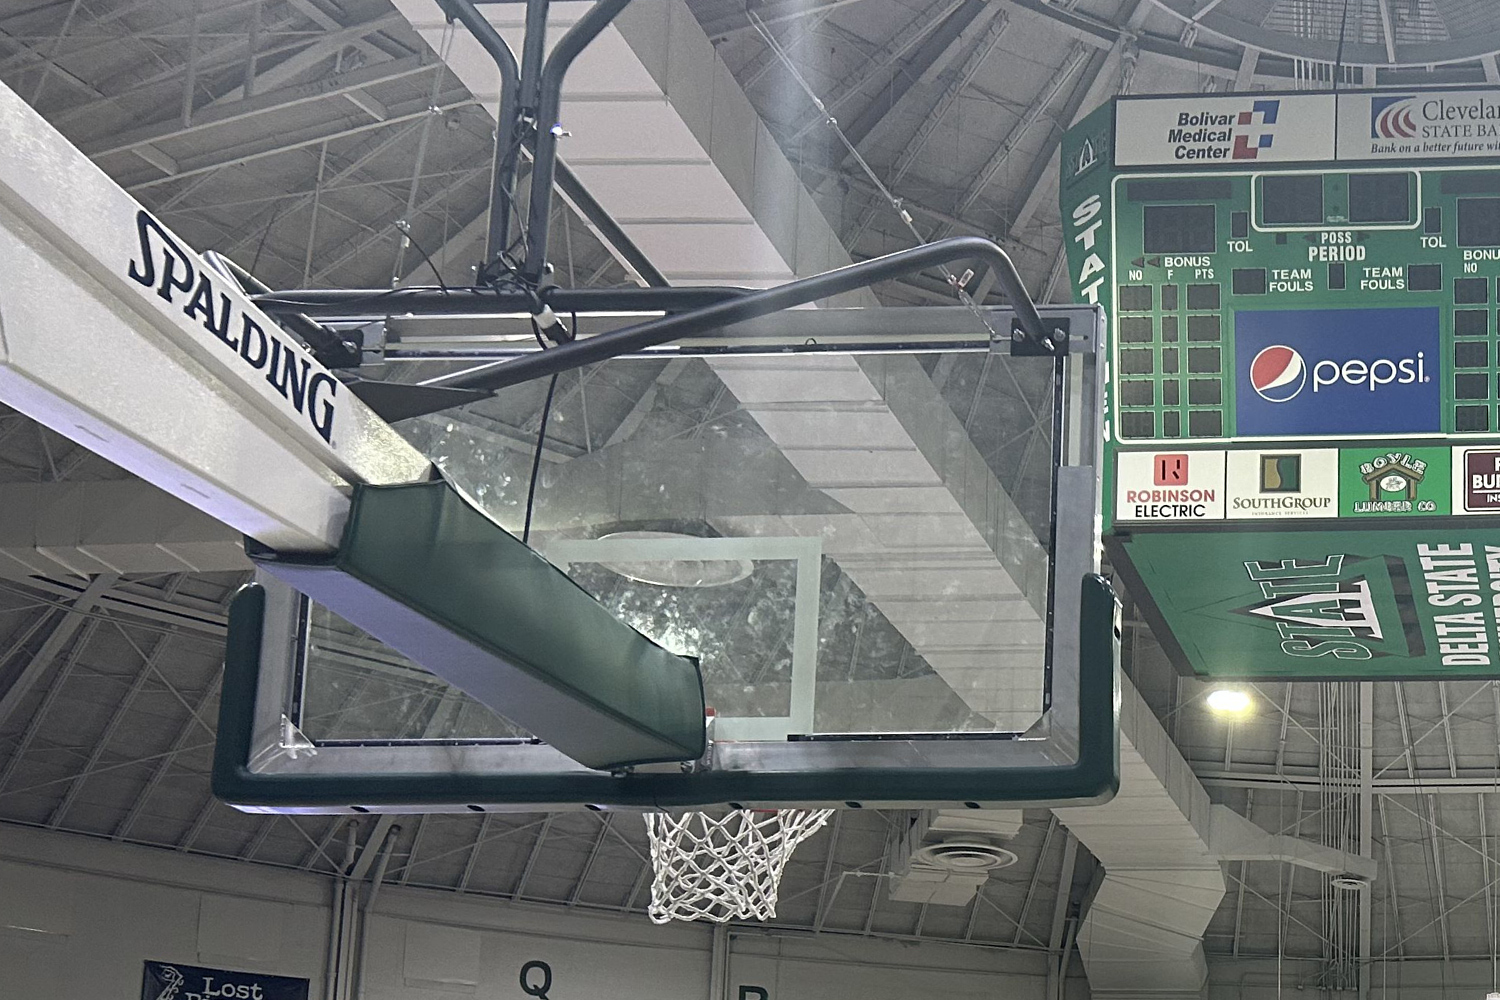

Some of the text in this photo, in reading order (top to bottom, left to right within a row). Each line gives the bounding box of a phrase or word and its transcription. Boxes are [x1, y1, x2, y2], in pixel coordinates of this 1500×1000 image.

[1178, 112, 1235, 126] Bolivar
[1168, 128, 1232, 143] Medical
[1422, 126, 1472, 138] STATE
[1175, 145, 1230, 159] Center
[1371, 143, 1396, 153] Bank
[1399, 145, 1410, 153] on
[1423, 142, 1451, 152] better
[1452, 141, 1484, 154] future
[1321, 232, 1352, 244] POSS
[1420, 237, 1446, 248] TOL
[1227, 241, 1253, 253] TOL
[1309, 246, 1365, 262] PERIOD
[1164, 257, 1210, 268] BONUS
[1464, 263, 1477, 273] NO
[1129, 270, 1142, 280] NO
[1168, 270, 1173, 280] F
[1195, 268, 1214, 279] PTS
[1272, 269, 1311, 279] TEAM
[1363, 267, 1402, 277] TEAM
[1270, 281, 1313, 292] FOULS
[1361, 279, 1404, 290] FOULS
[128, 210, 337, 444] SPALDING
[1313, 351, 1426, 392] pepsi
[1360, 452, 1427, 475] BOYLE
[1127, 490, 1215, 503] ROBINSON
[1135, 504, 1206, 518] ELECTRIC
[1353, 501, 1436, 513] LUMBER CO
[1417, 543, 1490, 666] DELTA STATE
[519, 960, 552, 1000] Q
[202, 977, 263, 1000] Lost
